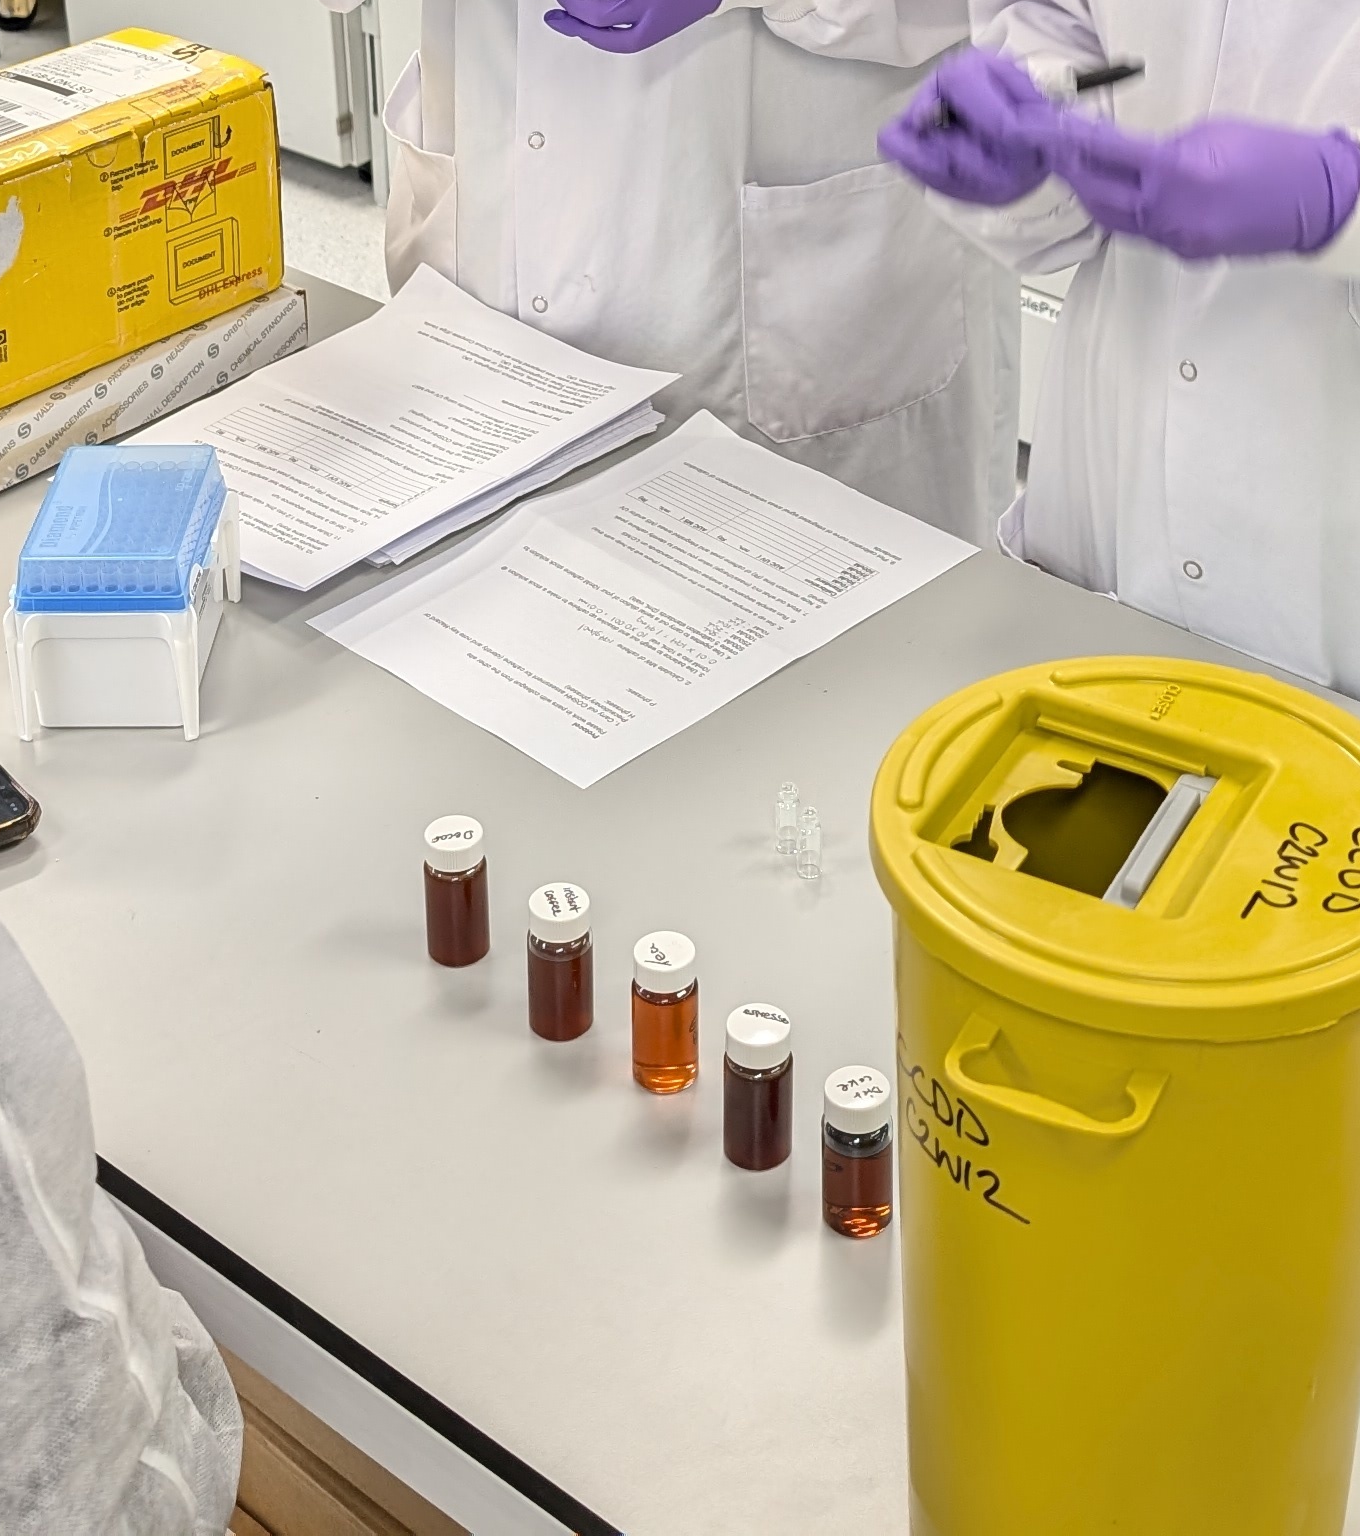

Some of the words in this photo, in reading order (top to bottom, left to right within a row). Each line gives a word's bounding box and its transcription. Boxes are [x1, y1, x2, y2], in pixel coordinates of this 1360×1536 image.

[171, 138, 206, 157] DOCUMENT
[139, 156, 239, 215] DHL
[182, 250, 217, 269] DOCUMENT
[198, 284, 223, 301] DHL
[223, 266, 264, 290] Express
[222, 318, 244, 342] ORBO
[230, 339, 264, 372] CHEMICAL
[261, 298, 298, 342] STANDARDS
[272, 321, 307, 362] DESORPTIO
[161, 359, 205, 408] DESORPTION
[33, 400, 55, 423] VIALS
[101, 379, 150, 433] ACCESSORIES
[29, 447, 47, 466] GAS
[45, 397, 95, 451] MANAGEMENT
[512, 680, 540, 698] colleague
[538, 695, 552, 704] with
[551, 701, 567, 712] pairs
[571, 721, 600, 739] Protocol
[431, 829, 474, 844] Decaf
